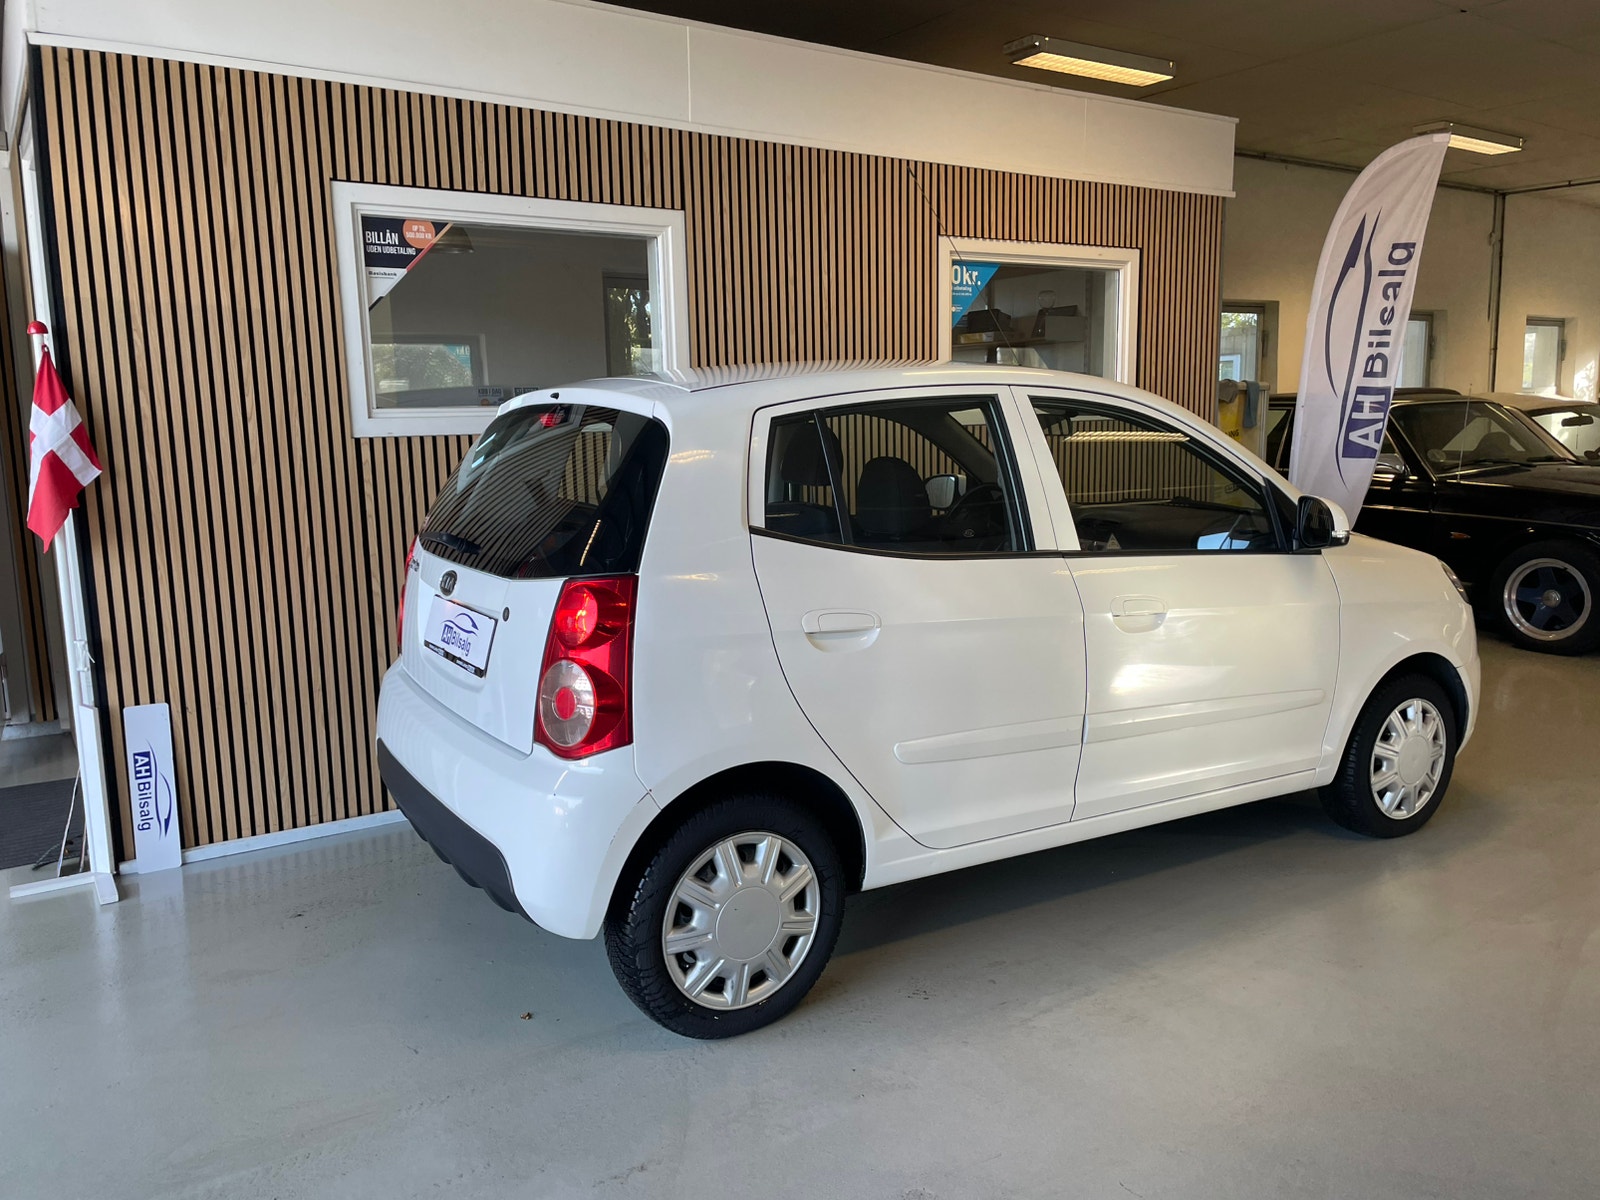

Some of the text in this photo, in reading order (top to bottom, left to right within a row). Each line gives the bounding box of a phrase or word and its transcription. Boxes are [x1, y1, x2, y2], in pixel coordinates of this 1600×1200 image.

[365, 229, 399, 245] BILLÅN
[366, 245, 416, 255] UDEN UDBETALING
[1347, 392, 1388, 454] AH
[450, 632, 471, 656] Bilsalg
[134, 755, 154, 832] AH Bilsalg
